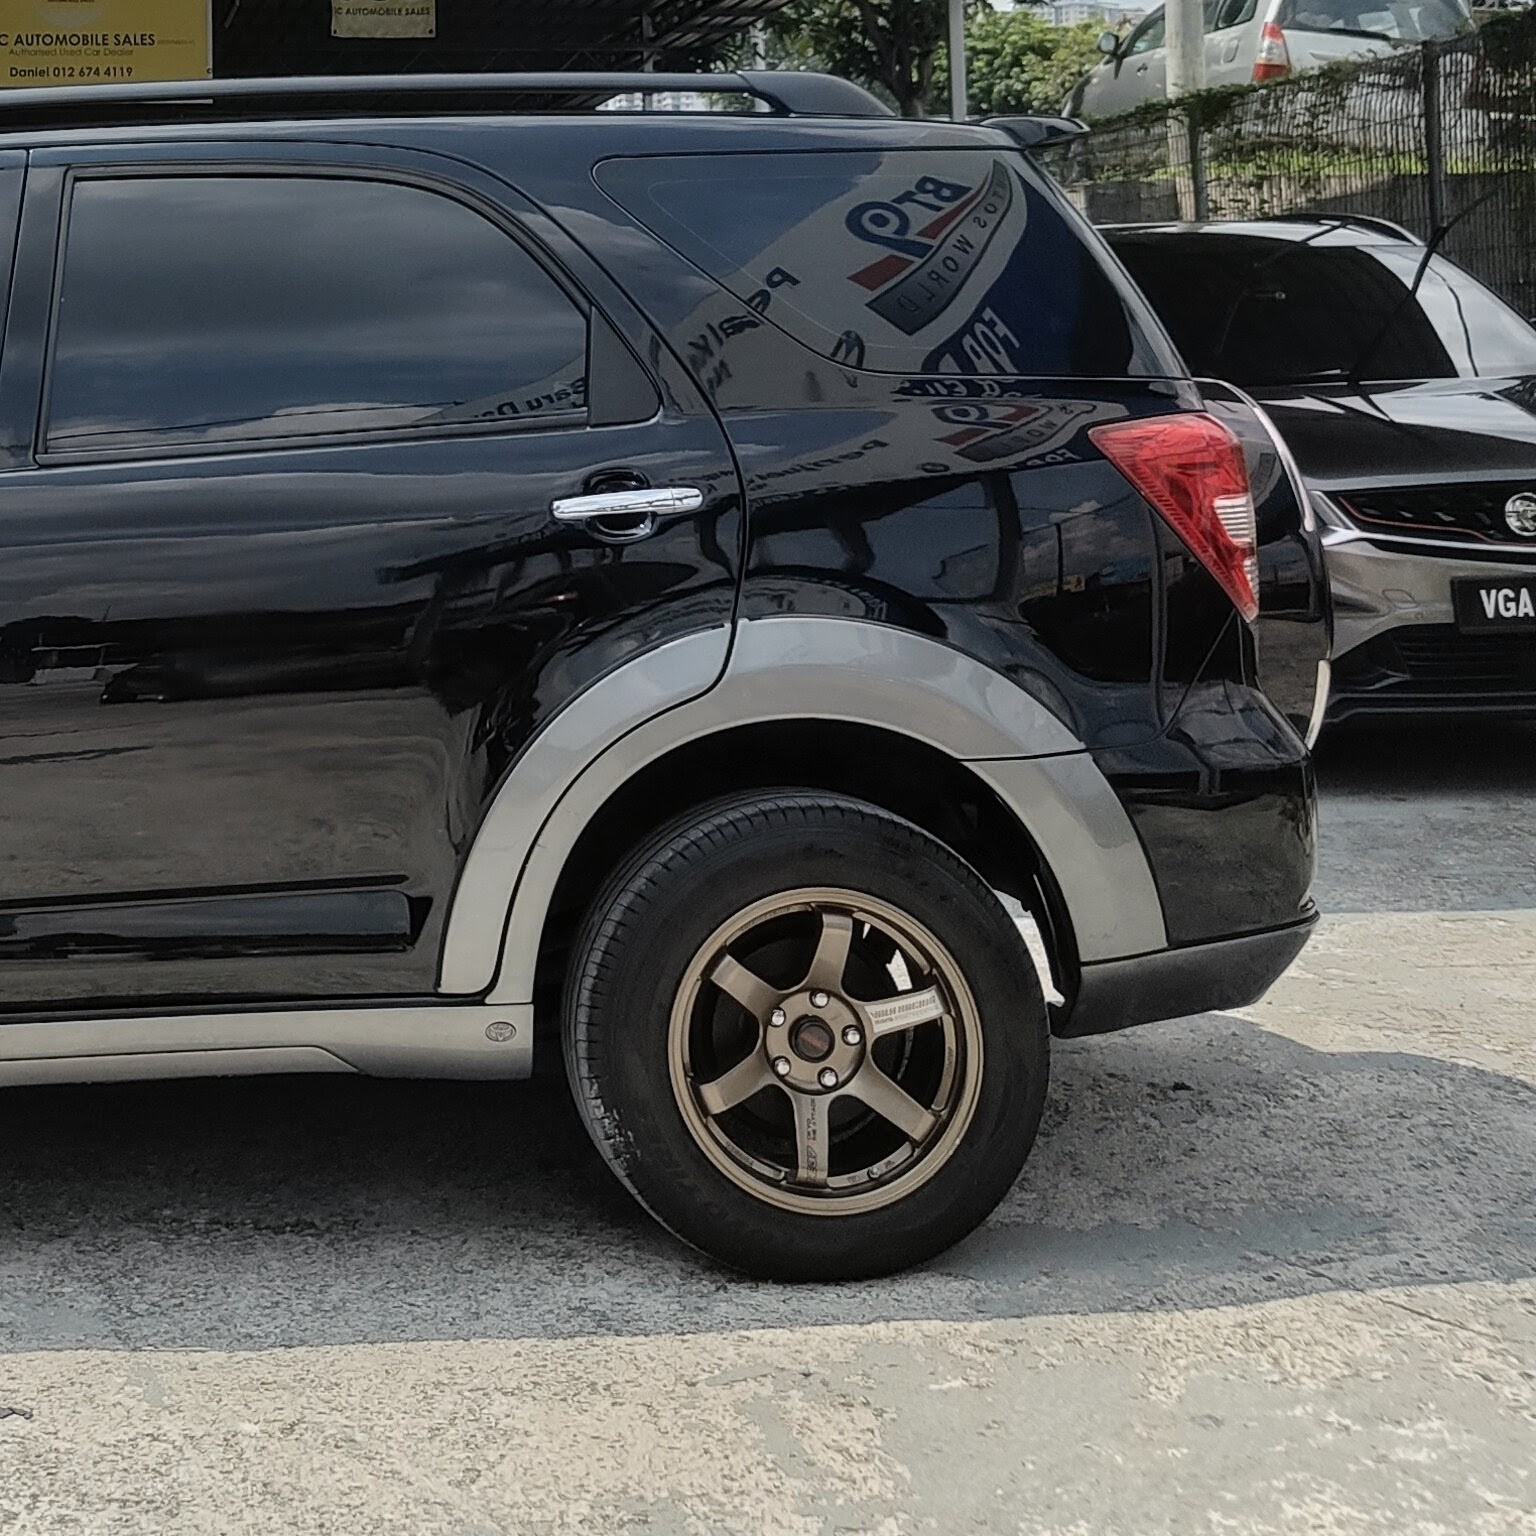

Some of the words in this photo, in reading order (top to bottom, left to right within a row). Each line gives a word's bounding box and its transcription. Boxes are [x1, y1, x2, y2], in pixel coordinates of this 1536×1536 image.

[345, 7, 403, 16] AUTOMOBILE
[405, 7, 431, 15] SALES
[14, 33, 109, 47] AUTOMOBILE
[112, 33, 156, 47] SALES
[9, 66, 50, 78] Daniel
[52, 66, 77, 78] 012
[78, 66, 102, 78] 674
[103, 66, 133, 78] 4119
